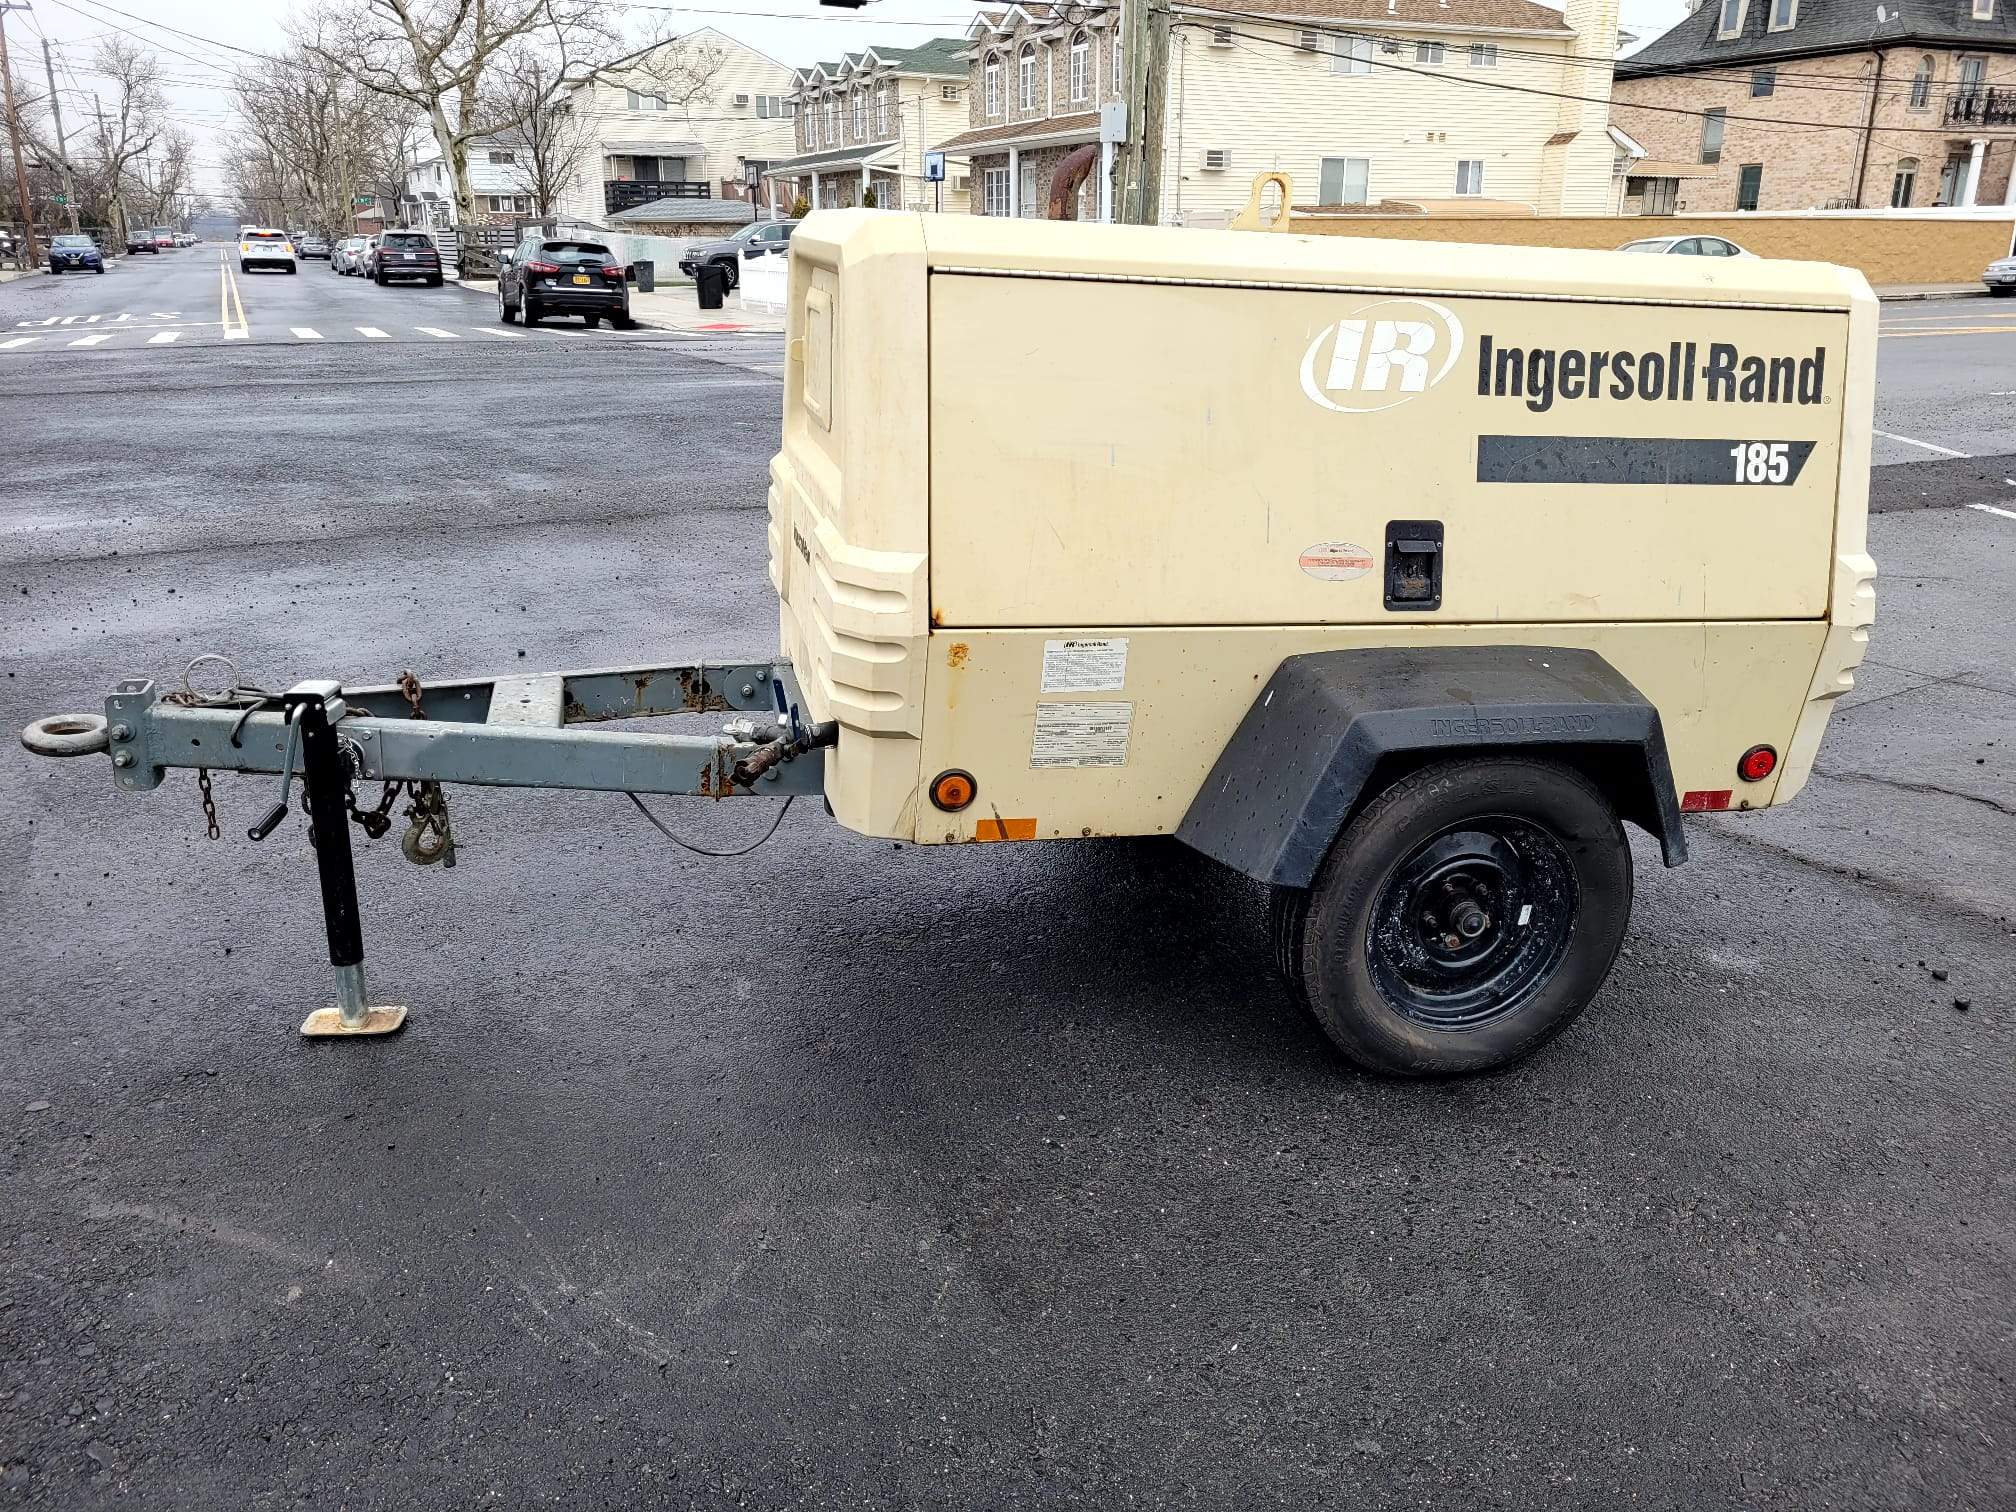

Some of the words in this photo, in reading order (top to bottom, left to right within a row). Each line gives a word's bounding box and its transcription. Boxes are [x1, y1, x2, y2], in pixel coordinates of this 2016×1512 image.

[1326, 320, 1435, 392] IR
[1477, 334, 1827, 412] Ingersoll-Rand
[1730, 442, 1789, 483] 185
